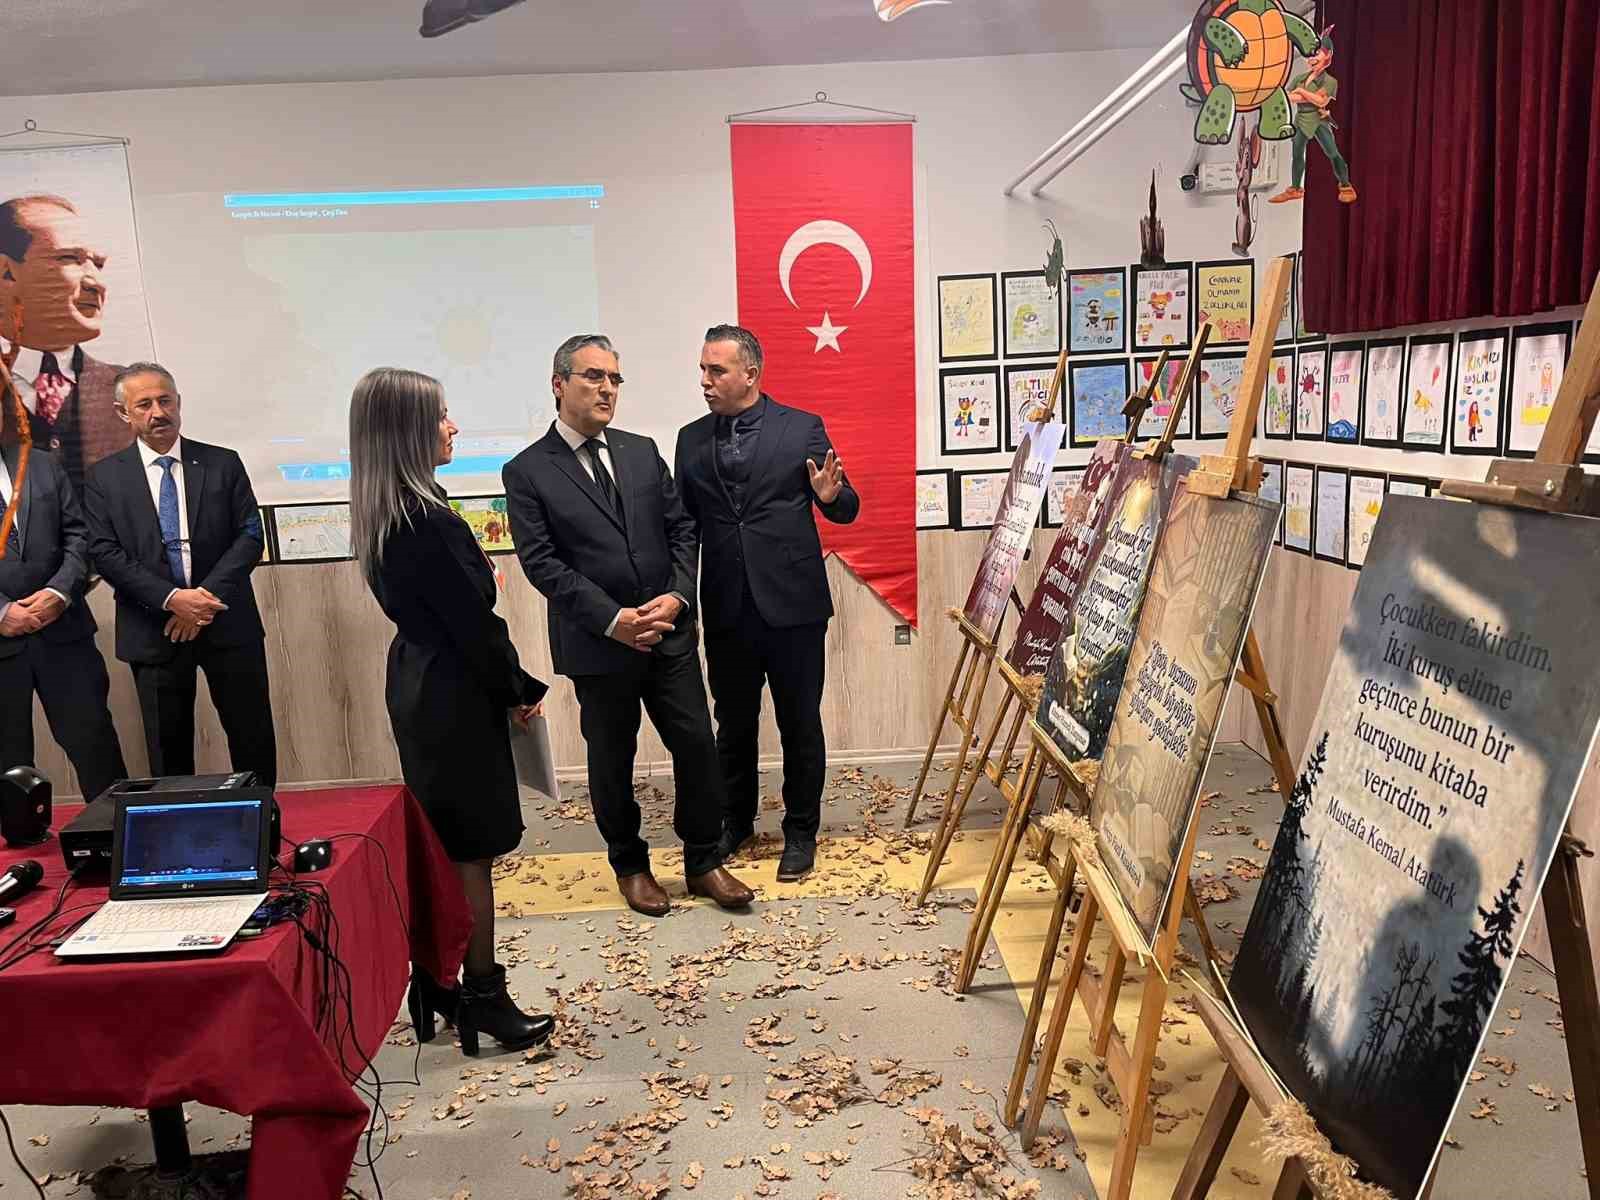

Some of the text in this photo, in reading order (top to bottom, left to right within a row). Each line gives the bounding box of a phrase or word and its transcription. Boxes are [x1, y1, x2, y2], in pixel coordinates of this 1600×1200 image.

[1110, 518, 1143, 553] Okumak
[1137, 525, 1152, 552] bir
[1103, 608, 1115, 633] bir
[1381, 593, 1553, 672] Çocukken fakirdim.
[1383, 631, 1513, 711] İki kuruş elime
[1354, 712, 1489, 808] kuruşunu kitaba
[1358, 677, 1516, 765] geçince bunun bir
[1326, 795, 1457, 909] Mustafa Kemal Atatürk
